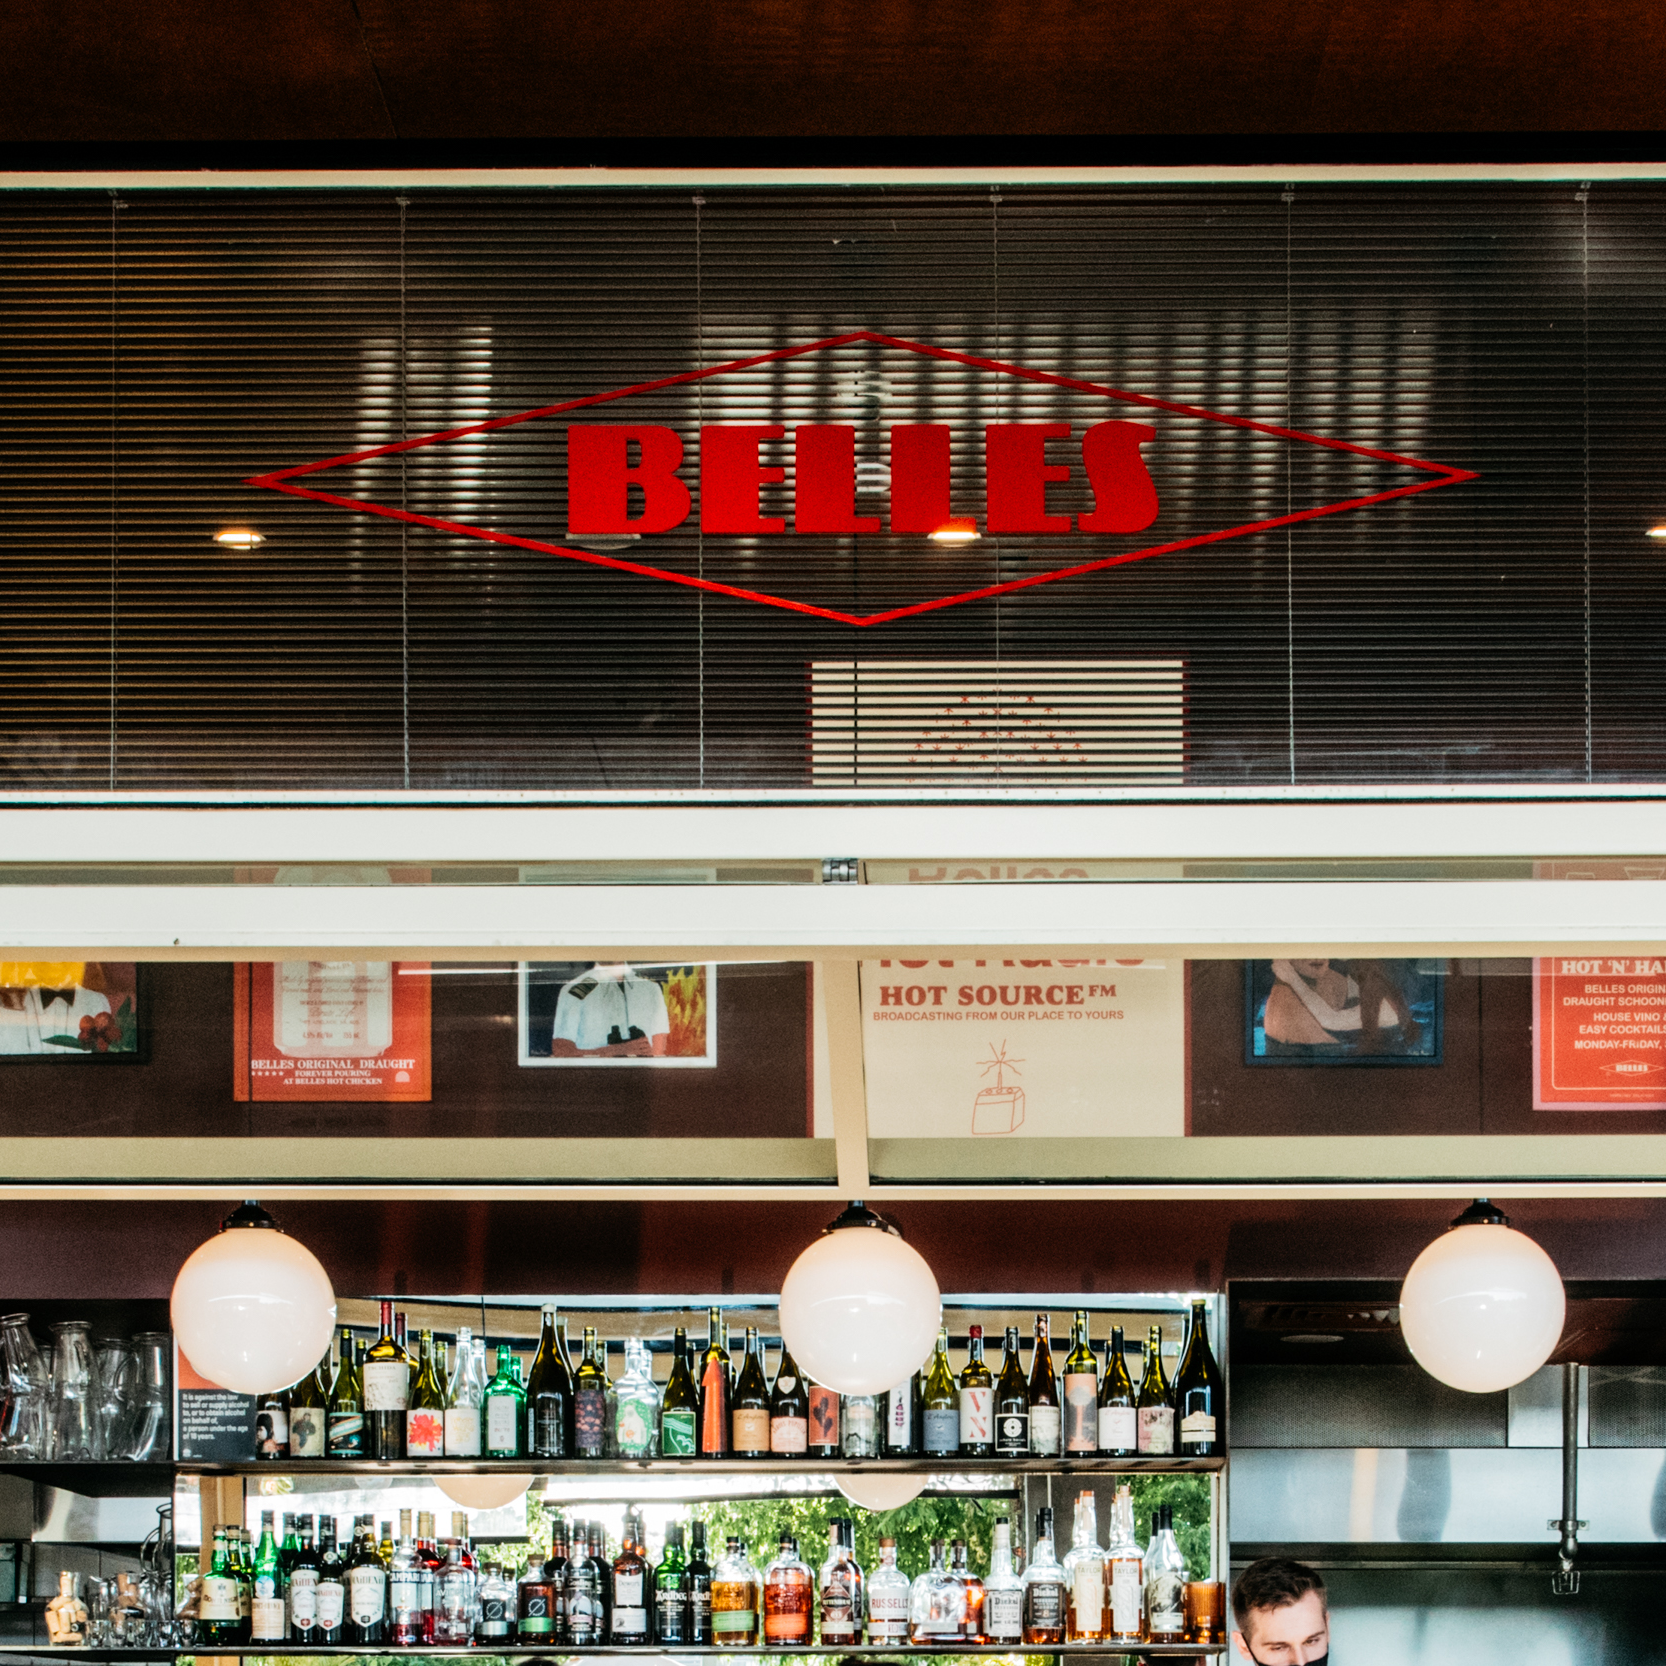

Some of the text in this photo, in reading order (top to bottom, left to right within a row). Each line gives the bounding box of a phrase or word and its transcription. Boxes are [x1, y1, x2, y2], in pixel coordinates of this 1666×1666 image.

[566, 420, 1160, 535] BELLES
[1561, 960, 1603, 974] HOT
[1585, 984, 1625, 994] BELLES
[879, 985, 948, 1007] HOT
[957, 985, 1085, 1007] SOURCE
[1563, 997, 1616, 1006] DRAUGHT
[872, 1009, 1125, 1022] BROADCASTING FROM OUR PLACE TO YOURS
[1593, 1012, 1632, 1022] HOUSE
[1633, 1012, 1661, 1022] VINO
[1579, 1025, 1607, 1034] EASY
[251, 1058, 416, 1070] BELLES ORIGINAL DRAUGHT
[295, 1069, 372, 1078] FOREVER POURING
[283, 1077, 384, 1085] AT BELLES HOT CHICKEN
